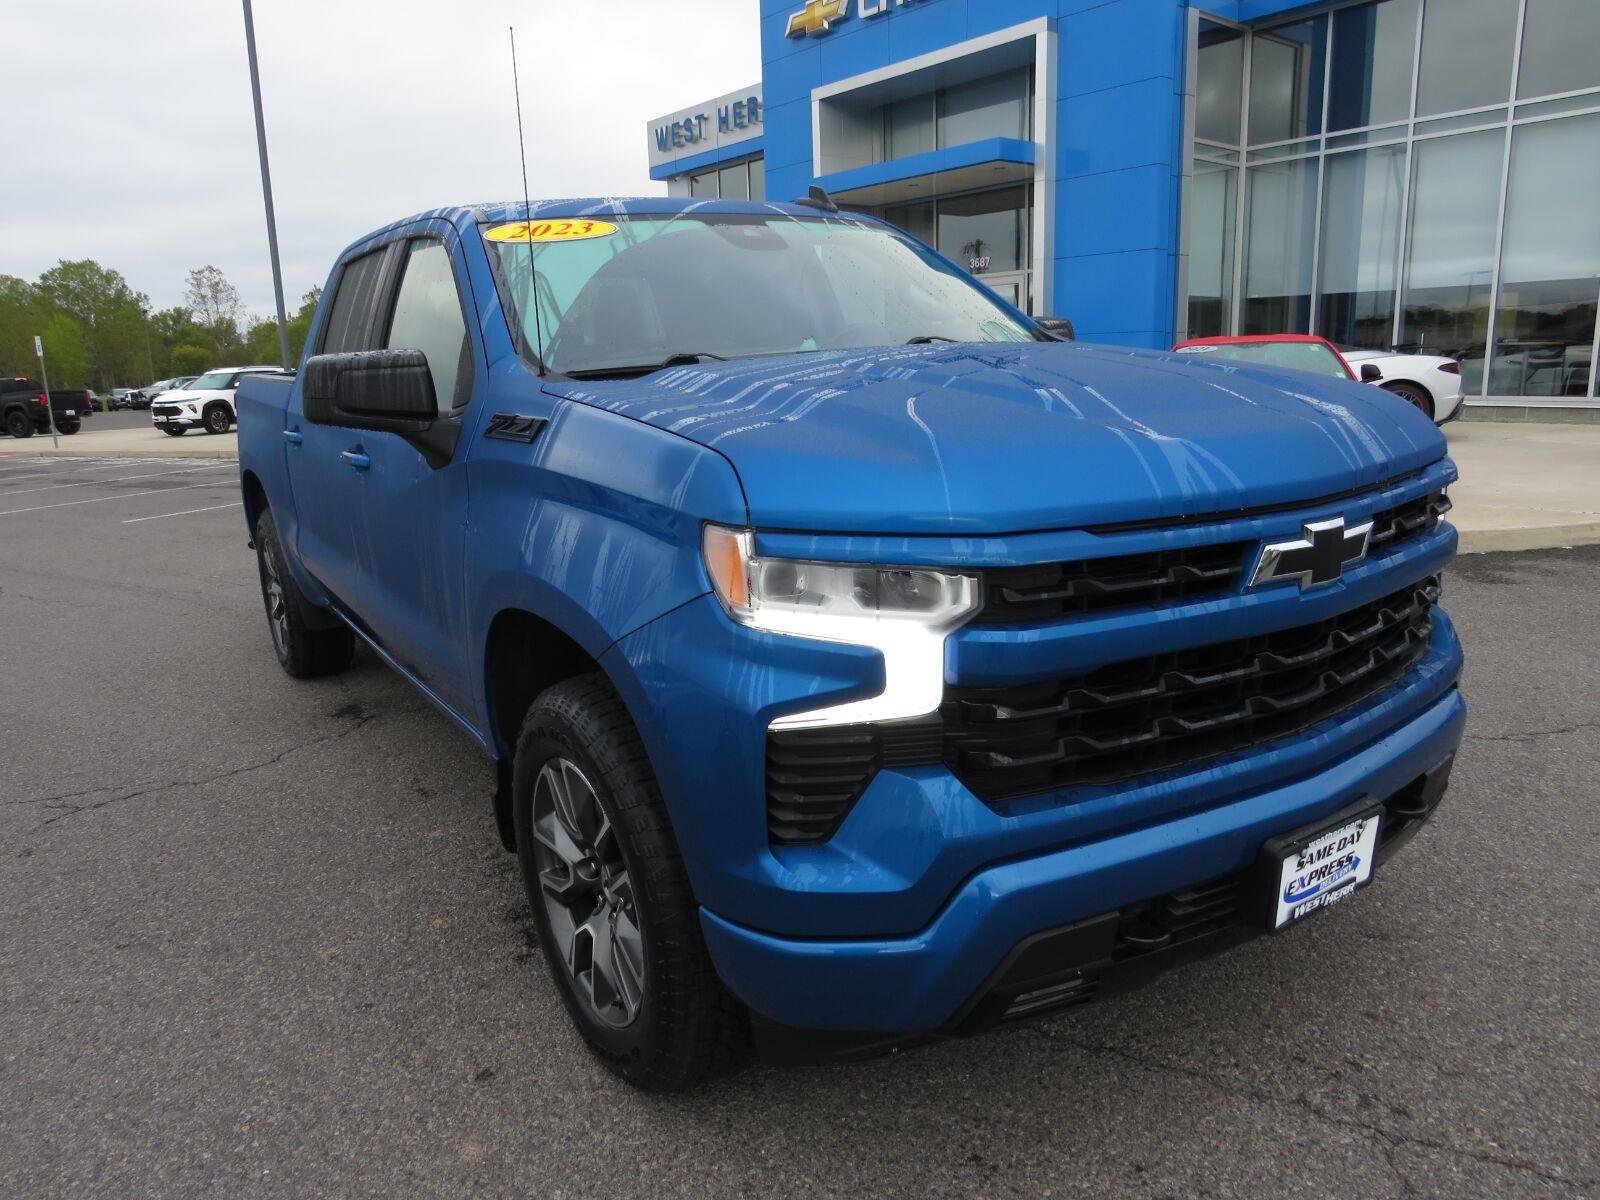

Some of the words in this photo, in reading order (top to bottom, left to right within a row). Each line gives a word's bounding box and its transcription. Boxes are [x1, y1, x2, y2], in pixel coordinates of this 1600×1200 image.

[655, 113, 706, 151] WEST
[507, 222, 595, 239] 2023
[970, 256, 991, 269] 3687
[1295, 841, 1336, 872] SAME
[1337, 829, 1364, 853] DAY
[1288, 851, 1355, 896] EXPRESS
